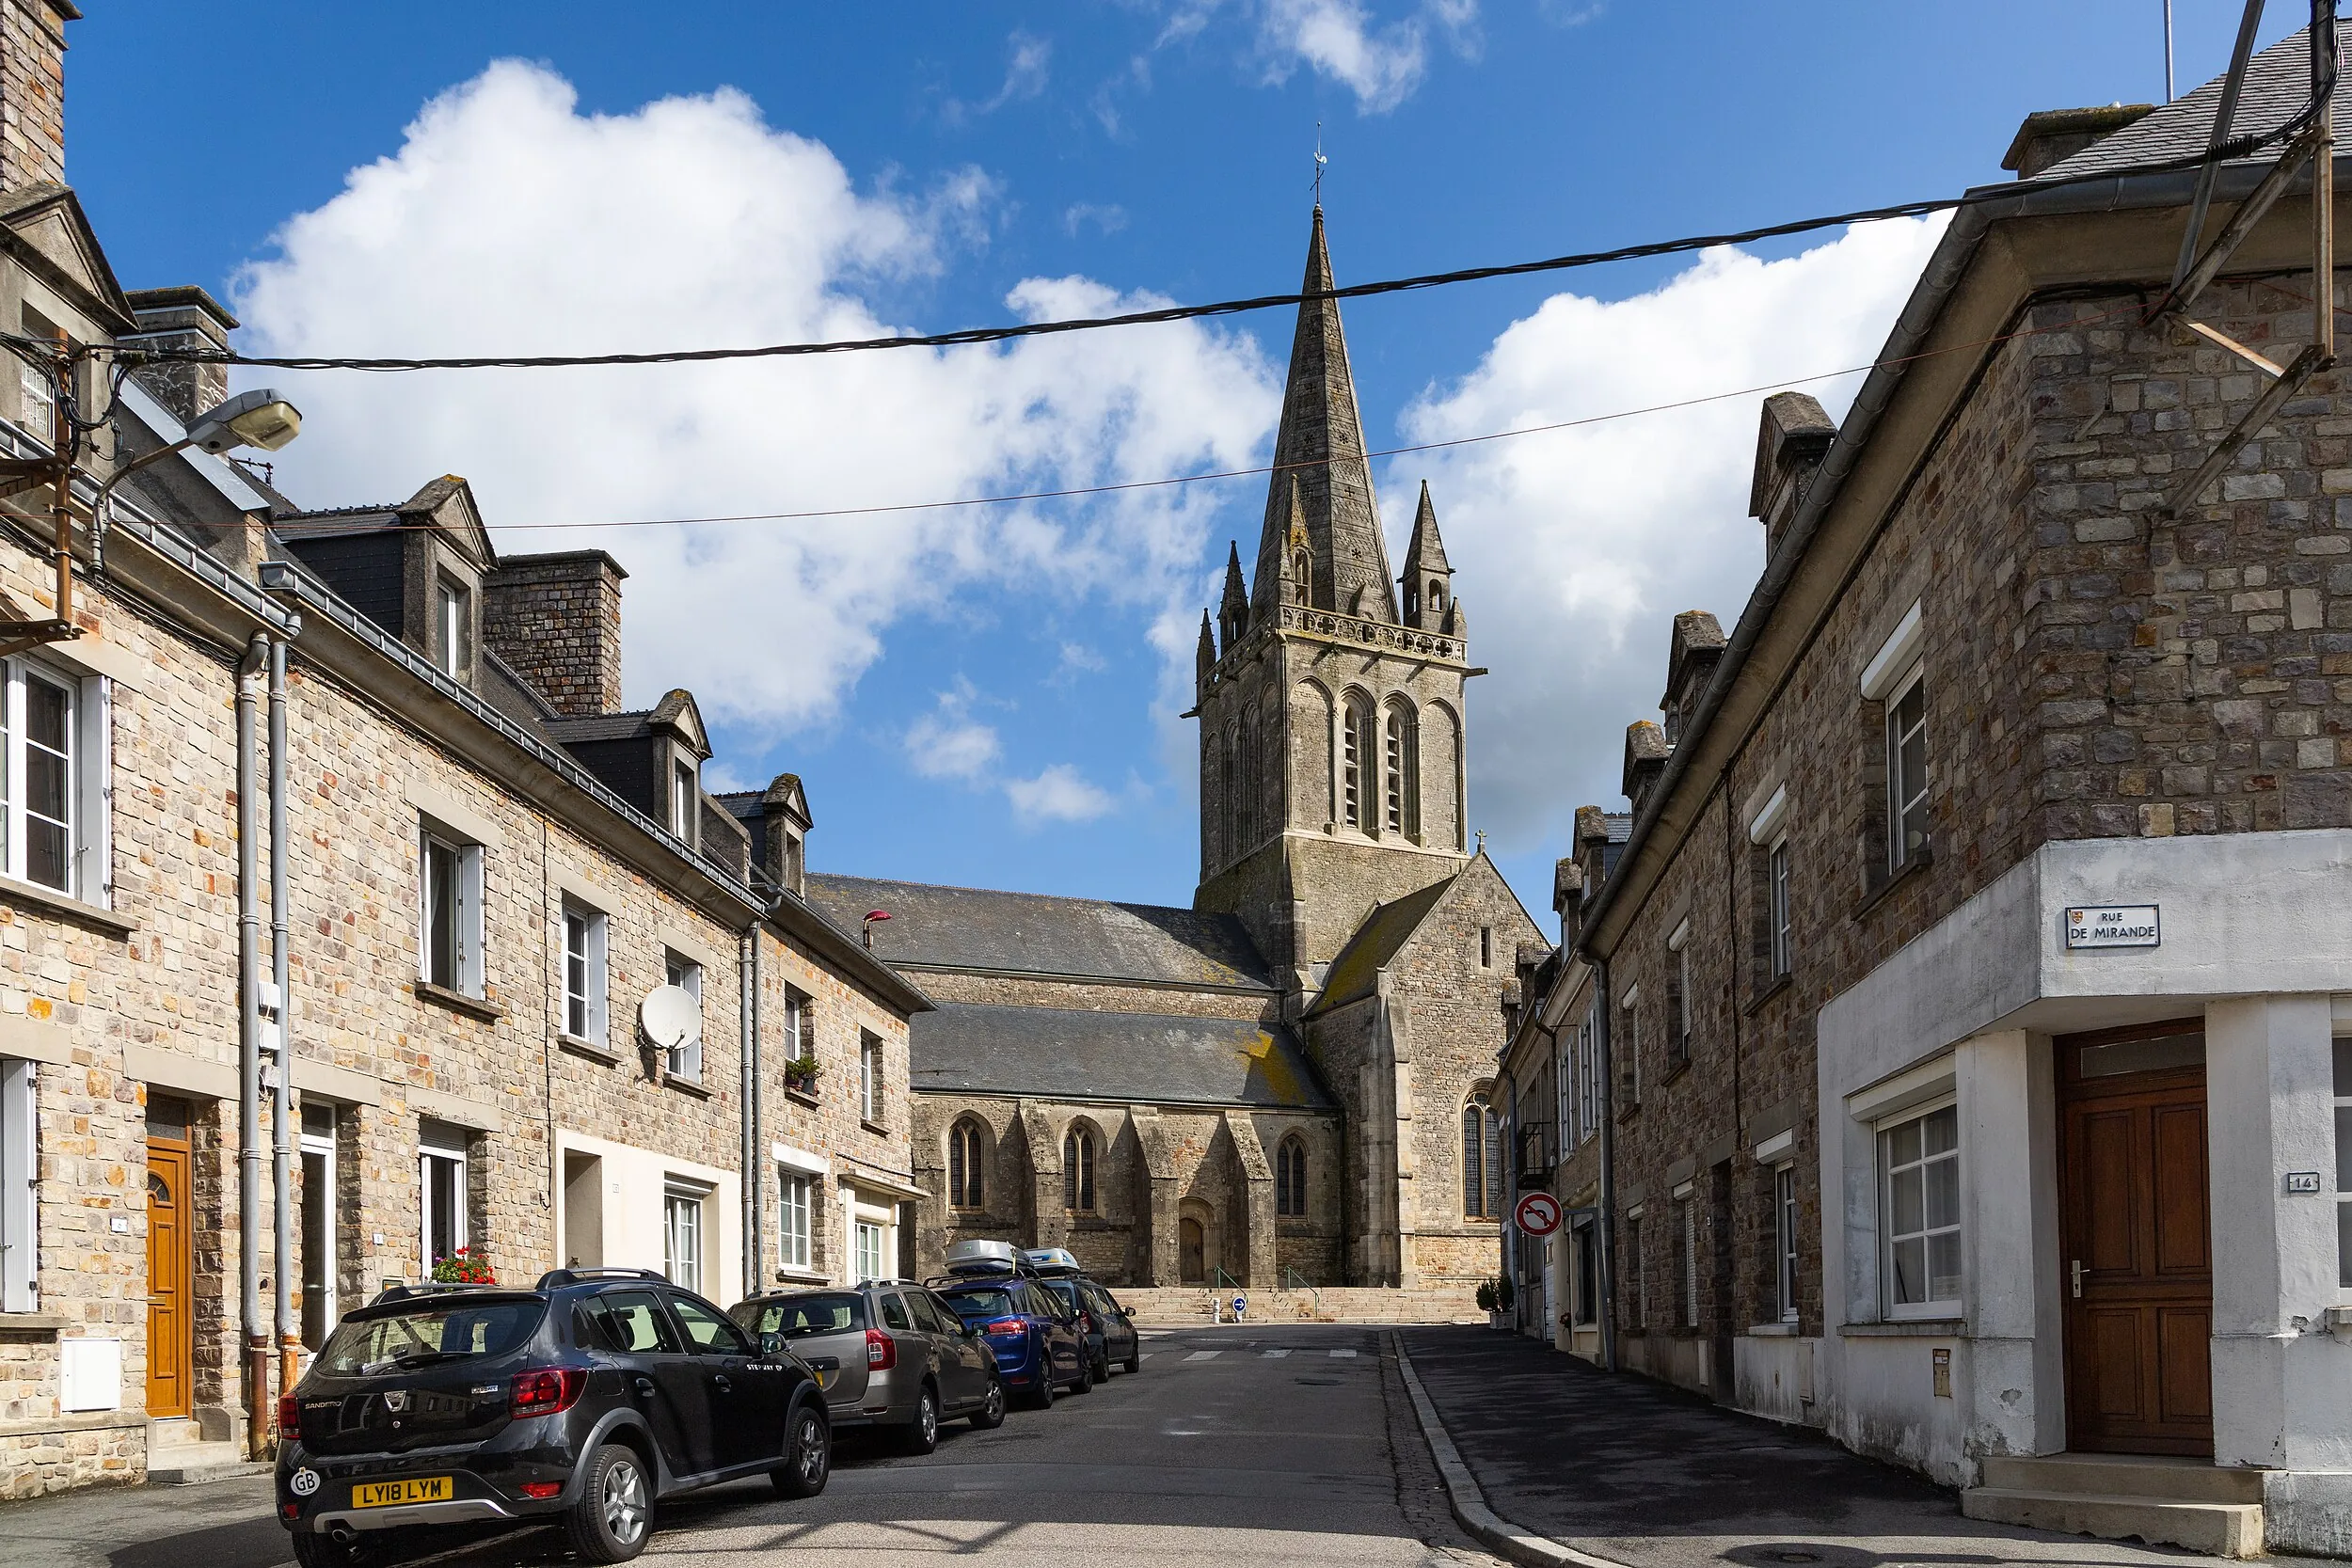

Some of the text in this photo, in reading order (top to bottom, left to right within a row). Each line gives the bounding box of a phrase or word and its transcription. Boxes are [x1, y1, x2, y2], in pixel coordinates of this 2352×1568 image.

[2102, 912, 2122, 922] RUE
[2071, 927, 2155, 939] DE MIRANDE
[2296, 1178, 2312, 1188] 14
[295, 1473, 315, 1491] GB
[363, 1480, 442, 1504] LY18 LYM
